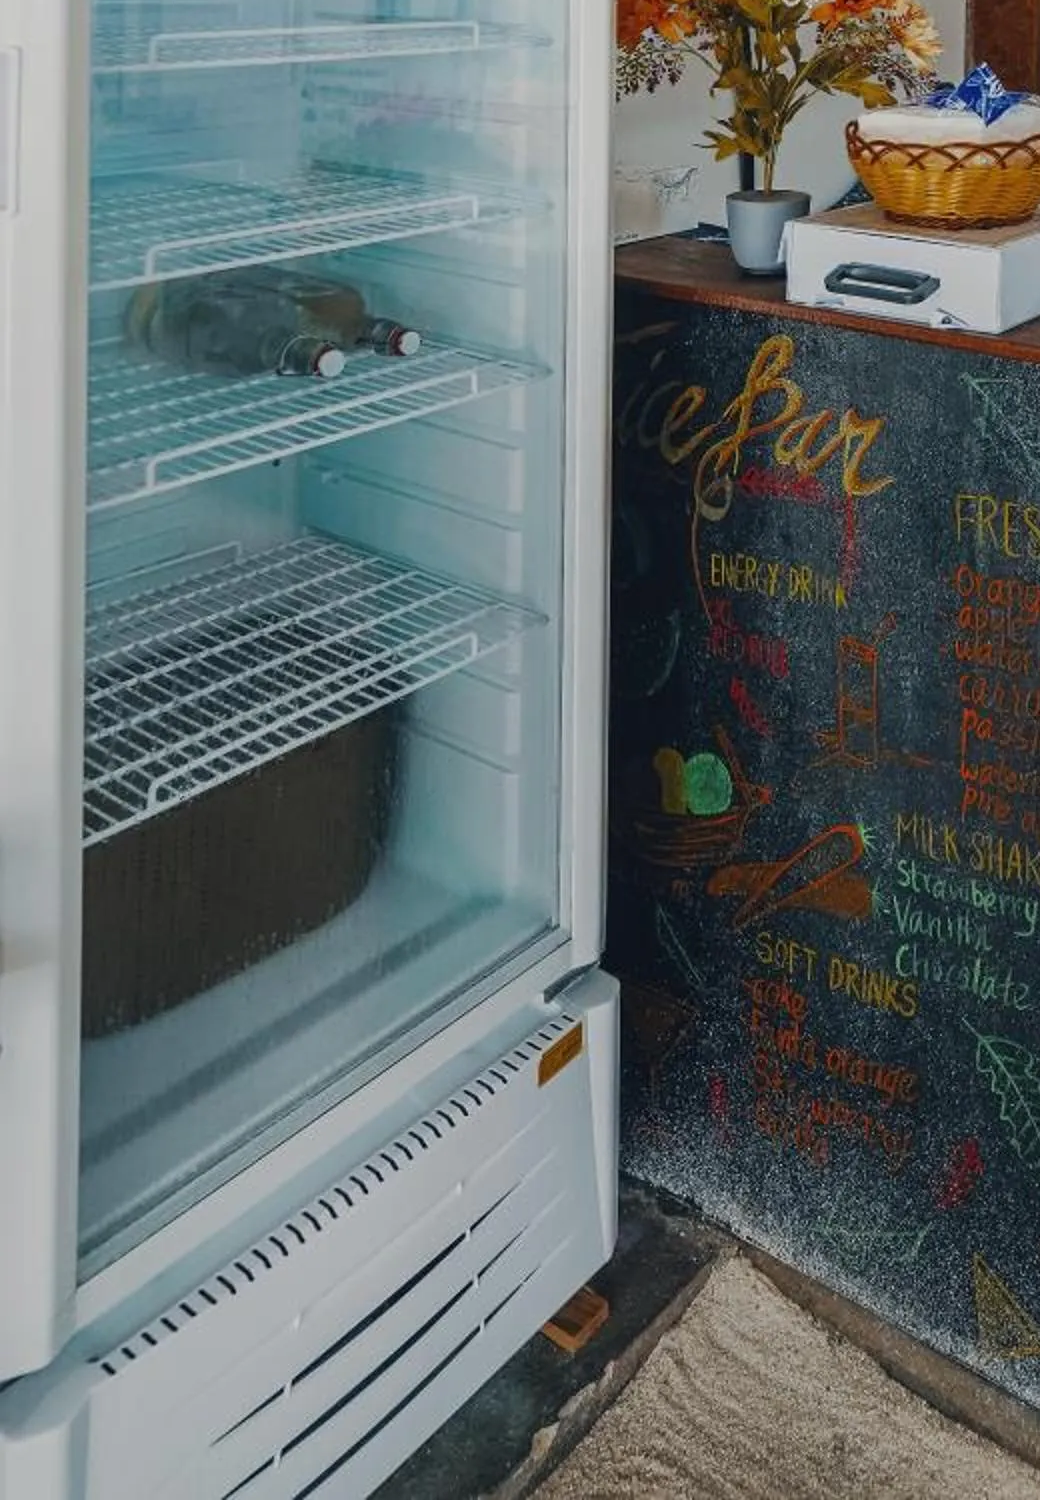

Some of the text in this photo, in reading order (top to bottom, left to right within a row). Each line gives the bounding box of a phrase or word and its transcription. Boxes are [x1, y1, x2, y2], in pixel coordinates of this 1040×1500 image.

[896, 813, 961, 865] MILK
[754, 932, 919, 1019] SOFT DRINKS
